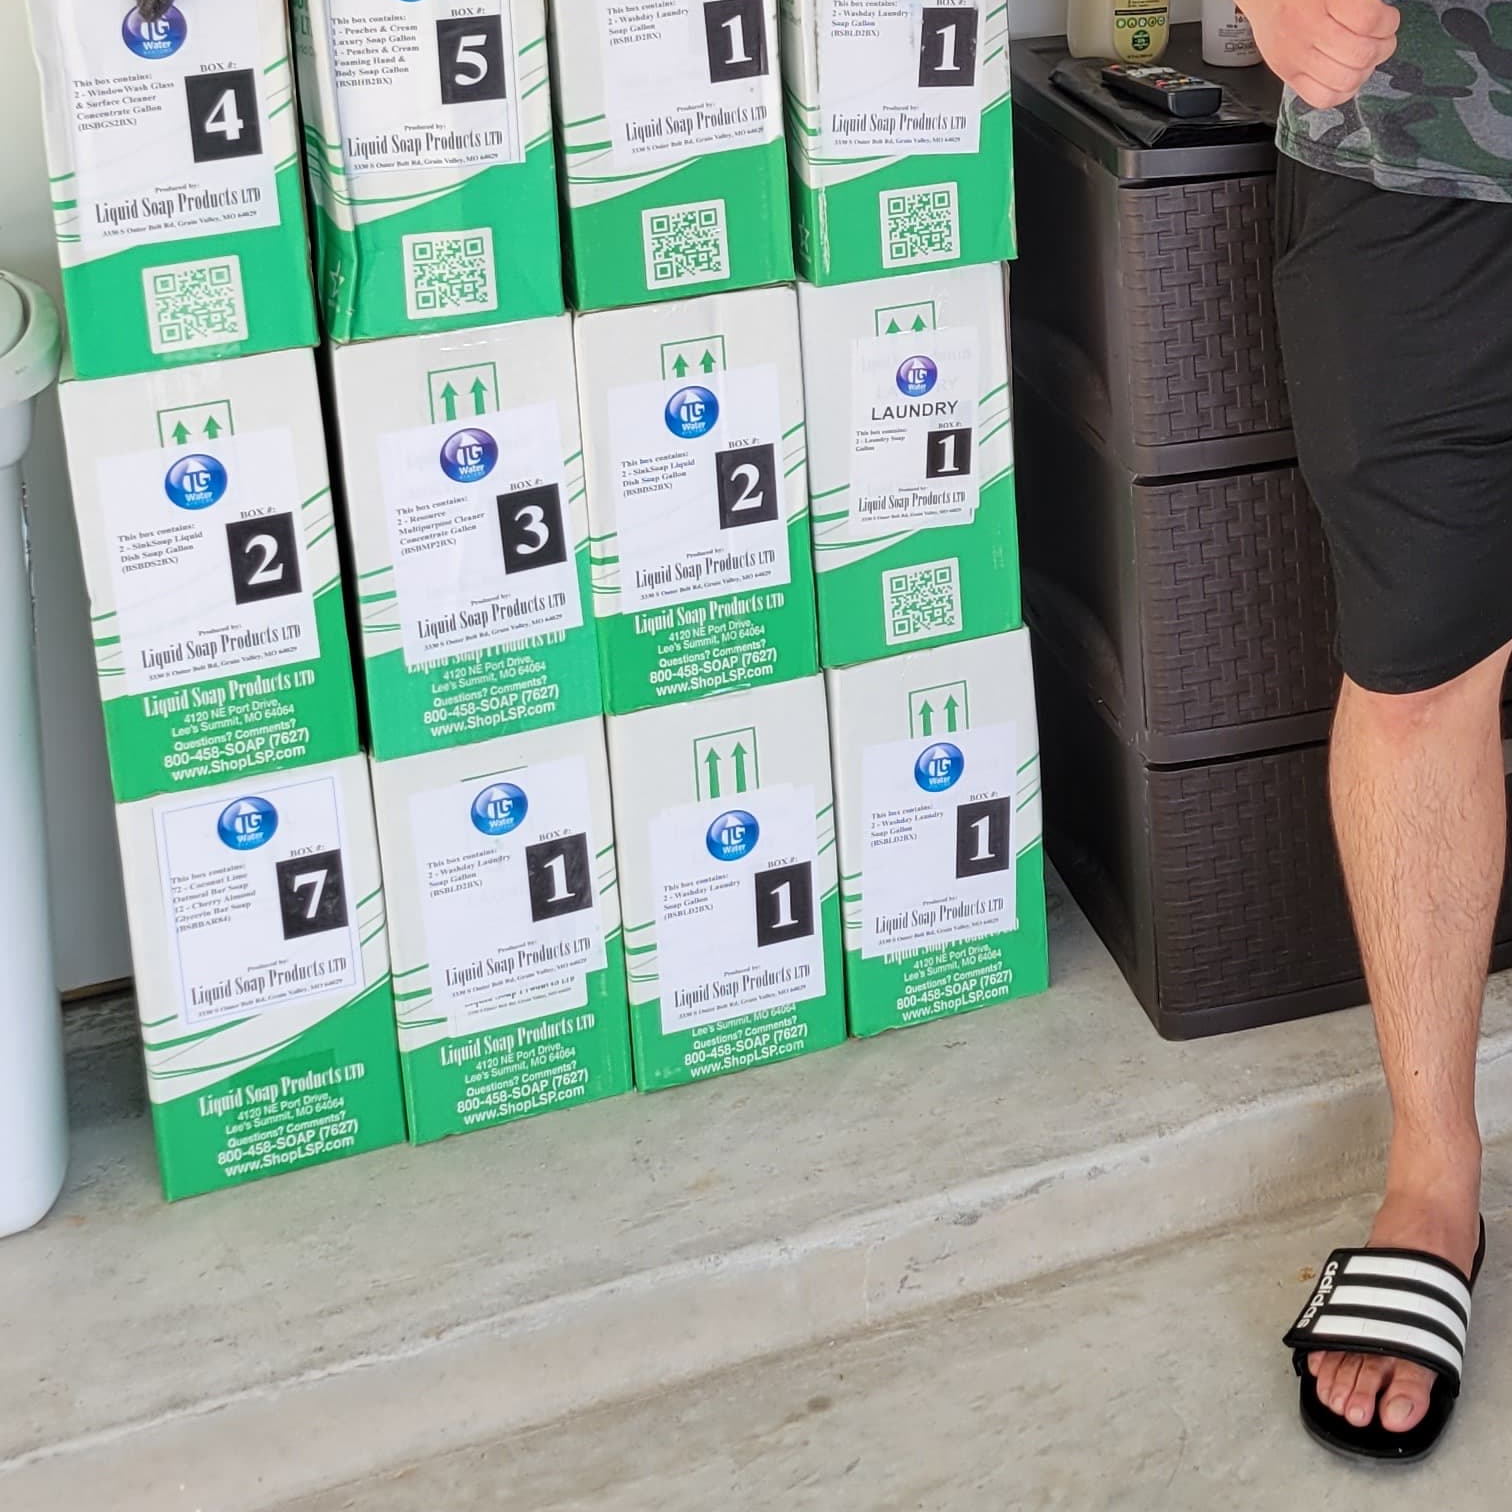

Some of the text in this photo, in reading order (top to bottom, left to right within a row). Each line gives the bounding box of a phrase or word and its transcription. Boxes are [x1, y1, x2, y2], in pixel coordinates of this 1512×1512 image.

[345, 26, 377, 35] Peaches
[390, 24, 418, 32] Cream
[369, 14, 406, 22] contains:
[451, 8, 473, 16] BOX
[143, 40, 171, 50] Water
[366, 36, 386, 46] Soap
[389, 35, 416, 43] Gallon
[721, 15, 753, 64] 1
[934, 24, 961, 71] 1
[200, 63, 224, 73] BOX
[454, 34, 488, 86] 5
[73, 73, 152, 88] This box contains:
[151, 80, 174, 90] Glass
[133, 104, 162, 114] Gallon
[205, 89, 244, 140] 4
[626, 105, 767, 142] Liquid Soap Products LTD
[349, 130, 502, 159] Liquid Soap Products LTD
[96, 187, 261, 226] Liquid Soap Products LTD
[872, 401, 958, 420] LAUNDRY
[458, 463, 484, 476] Water
[937, 435, 959, 472] 1
[730, 463, 764, 511] 2
[514, 504, 549, 555] 3
[244, 534, 284, 585] 2
[636, 550, 775, 589] Liquid Soap Products LTD
[418, 592, 566, 640] Liquid Soap Products LTD
[635, 592, 785, 635] Liquid Soap Products LTD
[142, 624, 300, 669] Liquid Soap Products LTD
[650, 648, 777, 683] 800-458-SOAP (7627)
[144, 669, 315, 719] Liquid Soap Products LTD
[656, 663, 773, 697] www.ShopLSP.com
[172, 725, 199, 738] Lee's
[244, 711, 262, 723] MO
[264, 704, 294, 718] 64064
[184, 711, 208, 724] 4120
[210, 707, 226, 720] NE
[228, 704, 250, 716] Port
[424, 683, 559, 724] 800-458-SOAP (7627)
[431, 700, 555, 737] www.ShopLSP.com
[164, 728, 310, 768] 800-458-SOAP (7627)
[174, 719, 296, 753] Questions? Comments?
[172, 744, 306, 782] www.ShopLSP.com
[969, 816, 996, 861] 1
[293, 869, 328, 919] 7
[543, 854, 576, 902] 1
[770, 881, 798, 929] 1
[192, 957, 347, 1007] Liquid Soap Products LTD
[674, 964, 810, 1010] Liquid Soap Products LTD
[897, 970, 1013, 1010] 800-458-SOAP (7627)
[902, 986, 1008, 1021] www.ShopLSP.com
[684, 1024, 808, 1066] 800-458-SOAP (7627)
[691, 1040, 804, 1078] www.ShopLSP.com
[457, 1069, 588, 1114] 800-458-SOAP (7627)
[463, 1086, 584, 1125] www.ShopLSP.com
[217, 1120, 358, 1165] 800-458-SOAP (7627)
[224, 1136, 354, 1177] www.ShopLSP.com
[1297, 1261, 1338, 1328] adidas
